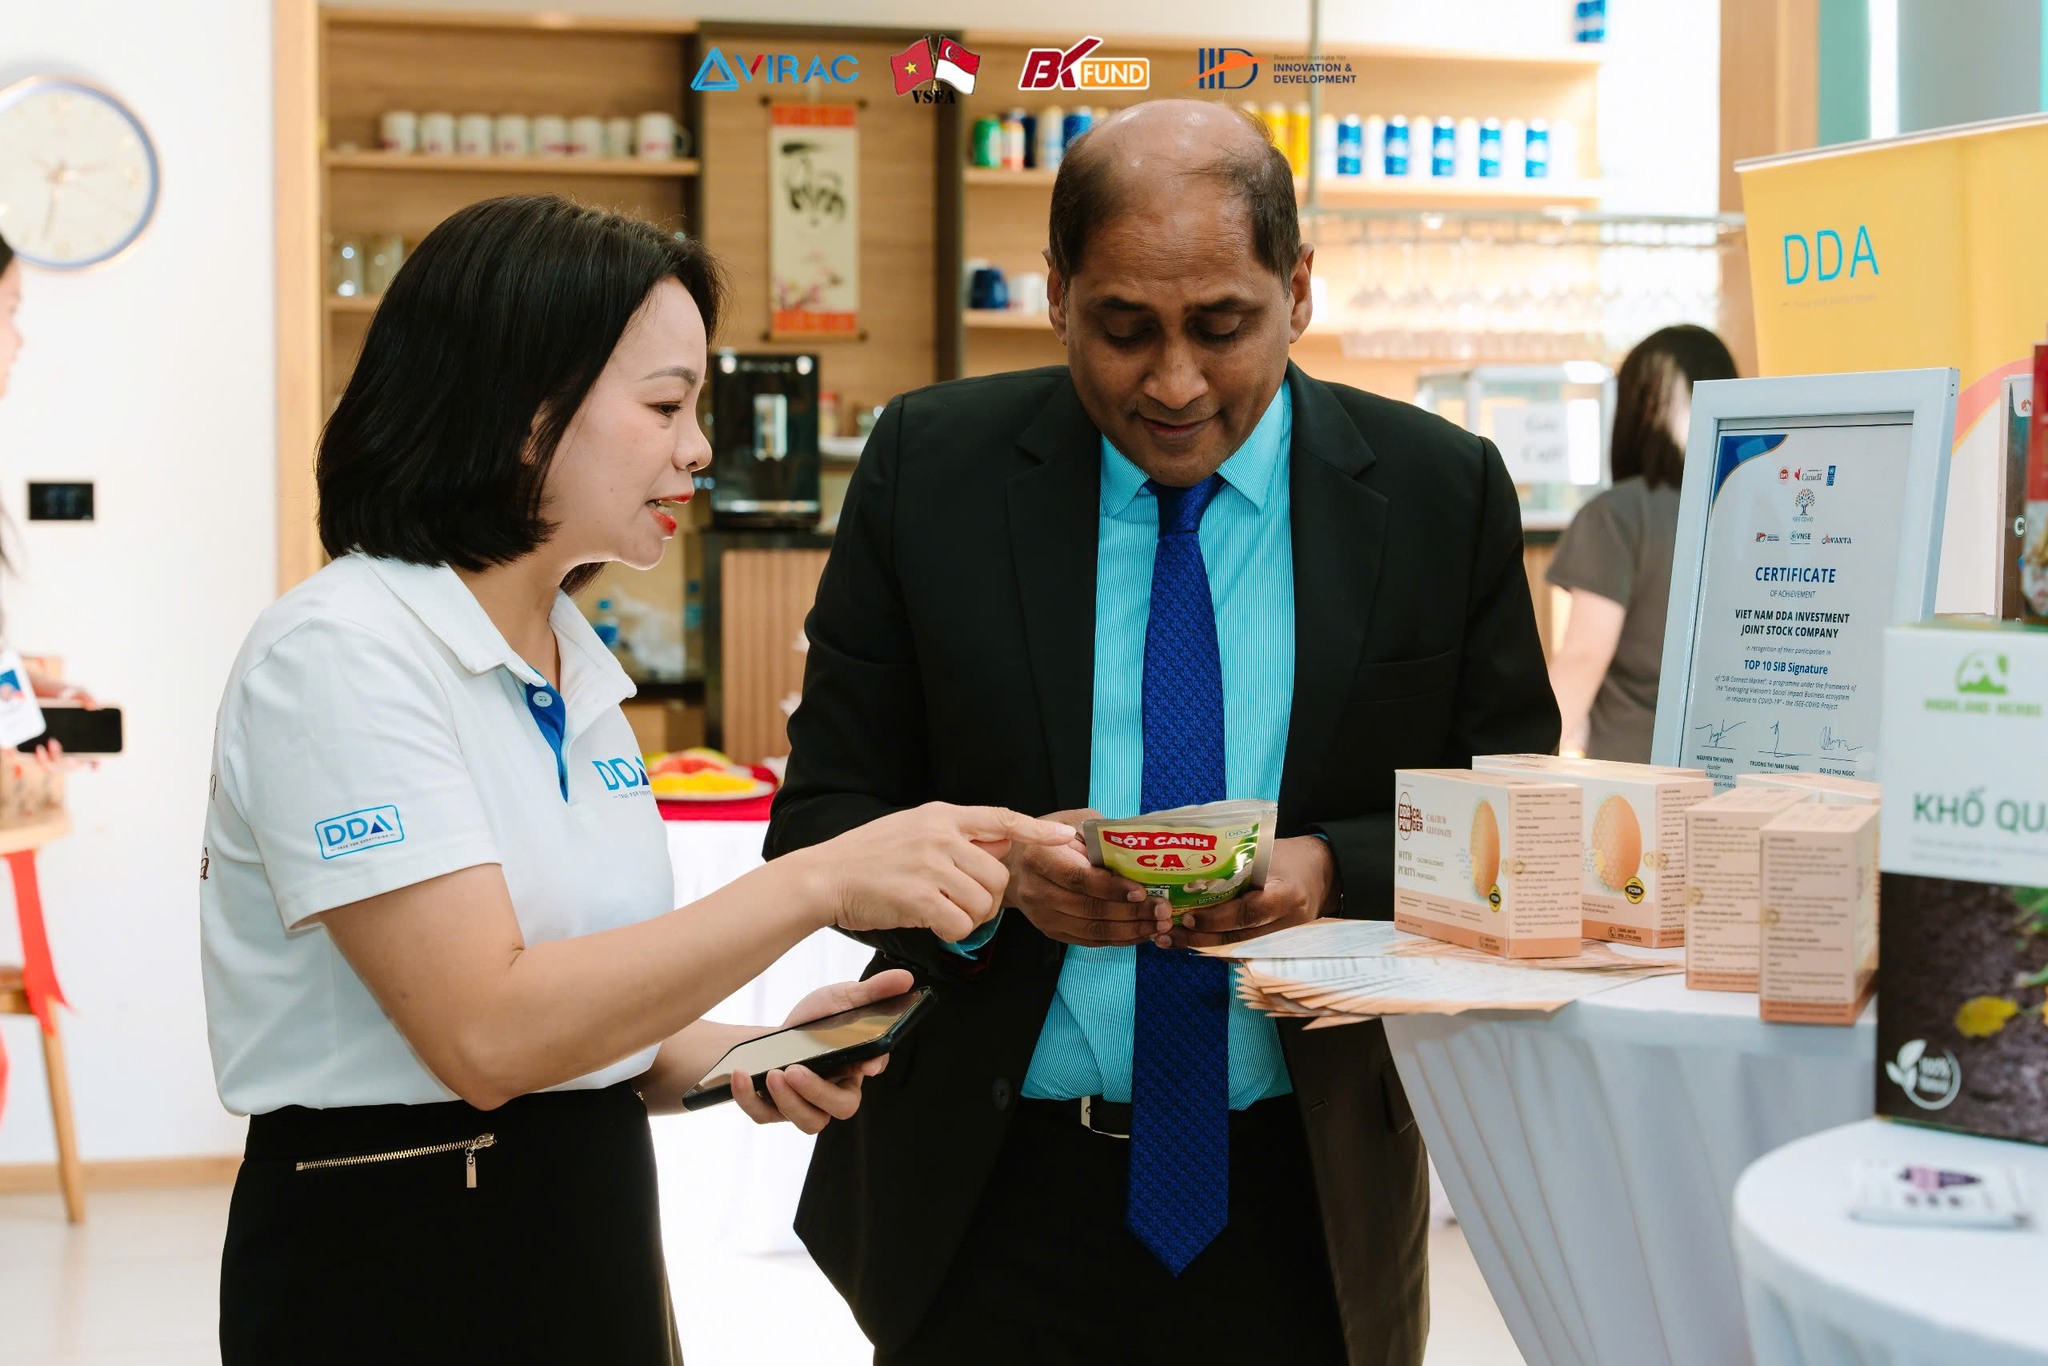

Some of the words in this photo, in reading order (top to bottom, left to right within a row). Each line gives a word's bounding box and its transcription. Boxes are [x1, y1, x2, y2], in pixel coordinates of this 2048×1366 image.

[1783, 224, 1879, 285] DDA
[1796, 532, 1812, 540] VNSE
[1755, 566, 1837, 583] CERTIFICATE
[1778, 590, 1816, 598] ACHIEVEMENT
[1735, 609, 1752, 619] VIET
[1754, 610, 1773, 620] NAM
[1776, 611, 1793, 621] DDA
[1795, 612, 1850, 624] INVESTMENT
[1741, 624, 1765, 636] JOINT
[1766, 625, 1793, 637] STOCK
[1795, 626, 1839, 638] COMPANY
[1795, 647, 1825, 656] participation
[1744, 659, 1761, 671] TOP
[1763, 660, 1771, 671] 10
[1773, 661, 1786, 672] SIB
[1788, 662, 1828, 675] Signature
[1730, 676, 1748, 684] Connect
[1773, 680, 1800, 689] programme
[1824, 682, 1850, 691] framework
[1825, 693, 1850, 701] ecosystem
[1821, 702, 1839, 710] Project
[1995, 799, 2048, 834] QU
[323, 813, 393, 847] DDA
[1426, 826, 1452, 838] GLUCONATE
[1110, 834, 1151, 849] BỘT
[1153, 835, 1209, 848] CANH
[1398, 850, 1412, 861] WITH
[1398, 865, 1416, 878] PURITY
